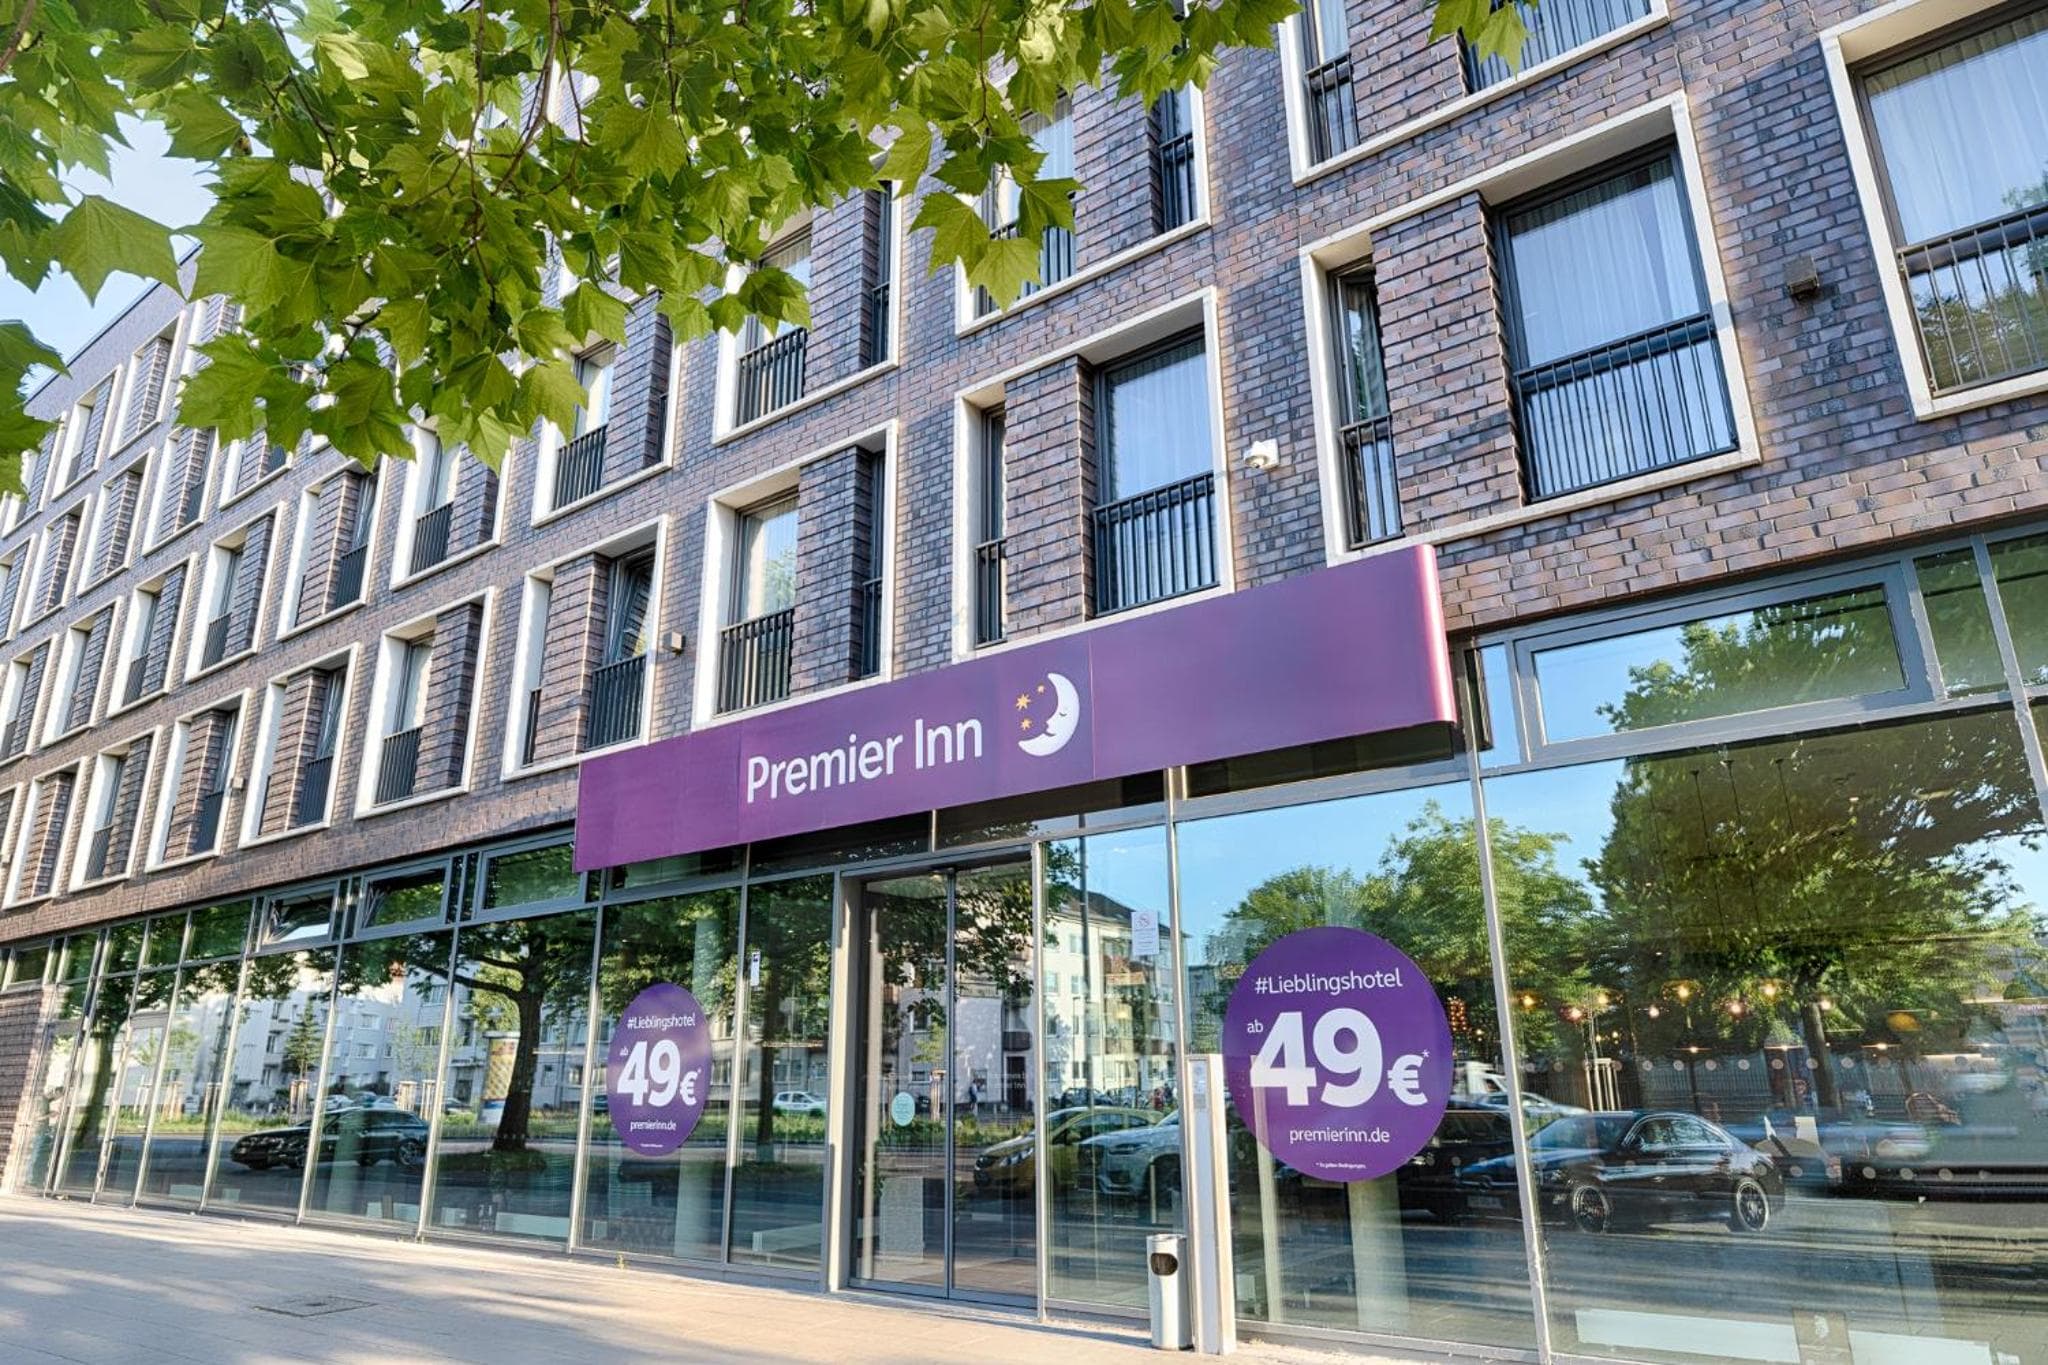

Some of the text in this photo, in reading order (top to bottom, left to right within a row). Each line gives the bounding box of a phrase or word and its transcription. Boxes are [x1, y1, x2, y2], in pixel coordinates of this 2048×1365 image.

[746, 717, 984, 805] Premier Inn
[1254, 967, 1404, 997] #Lieblingshotel
[627, 1013, 696, 1031] #Lieblingshotel
[1246, 1018, 1264, 1034] ab
[629, 1119, 677, 1132] premierinn.de
[1289, 1126, 1391, 1145] premierinn.de
